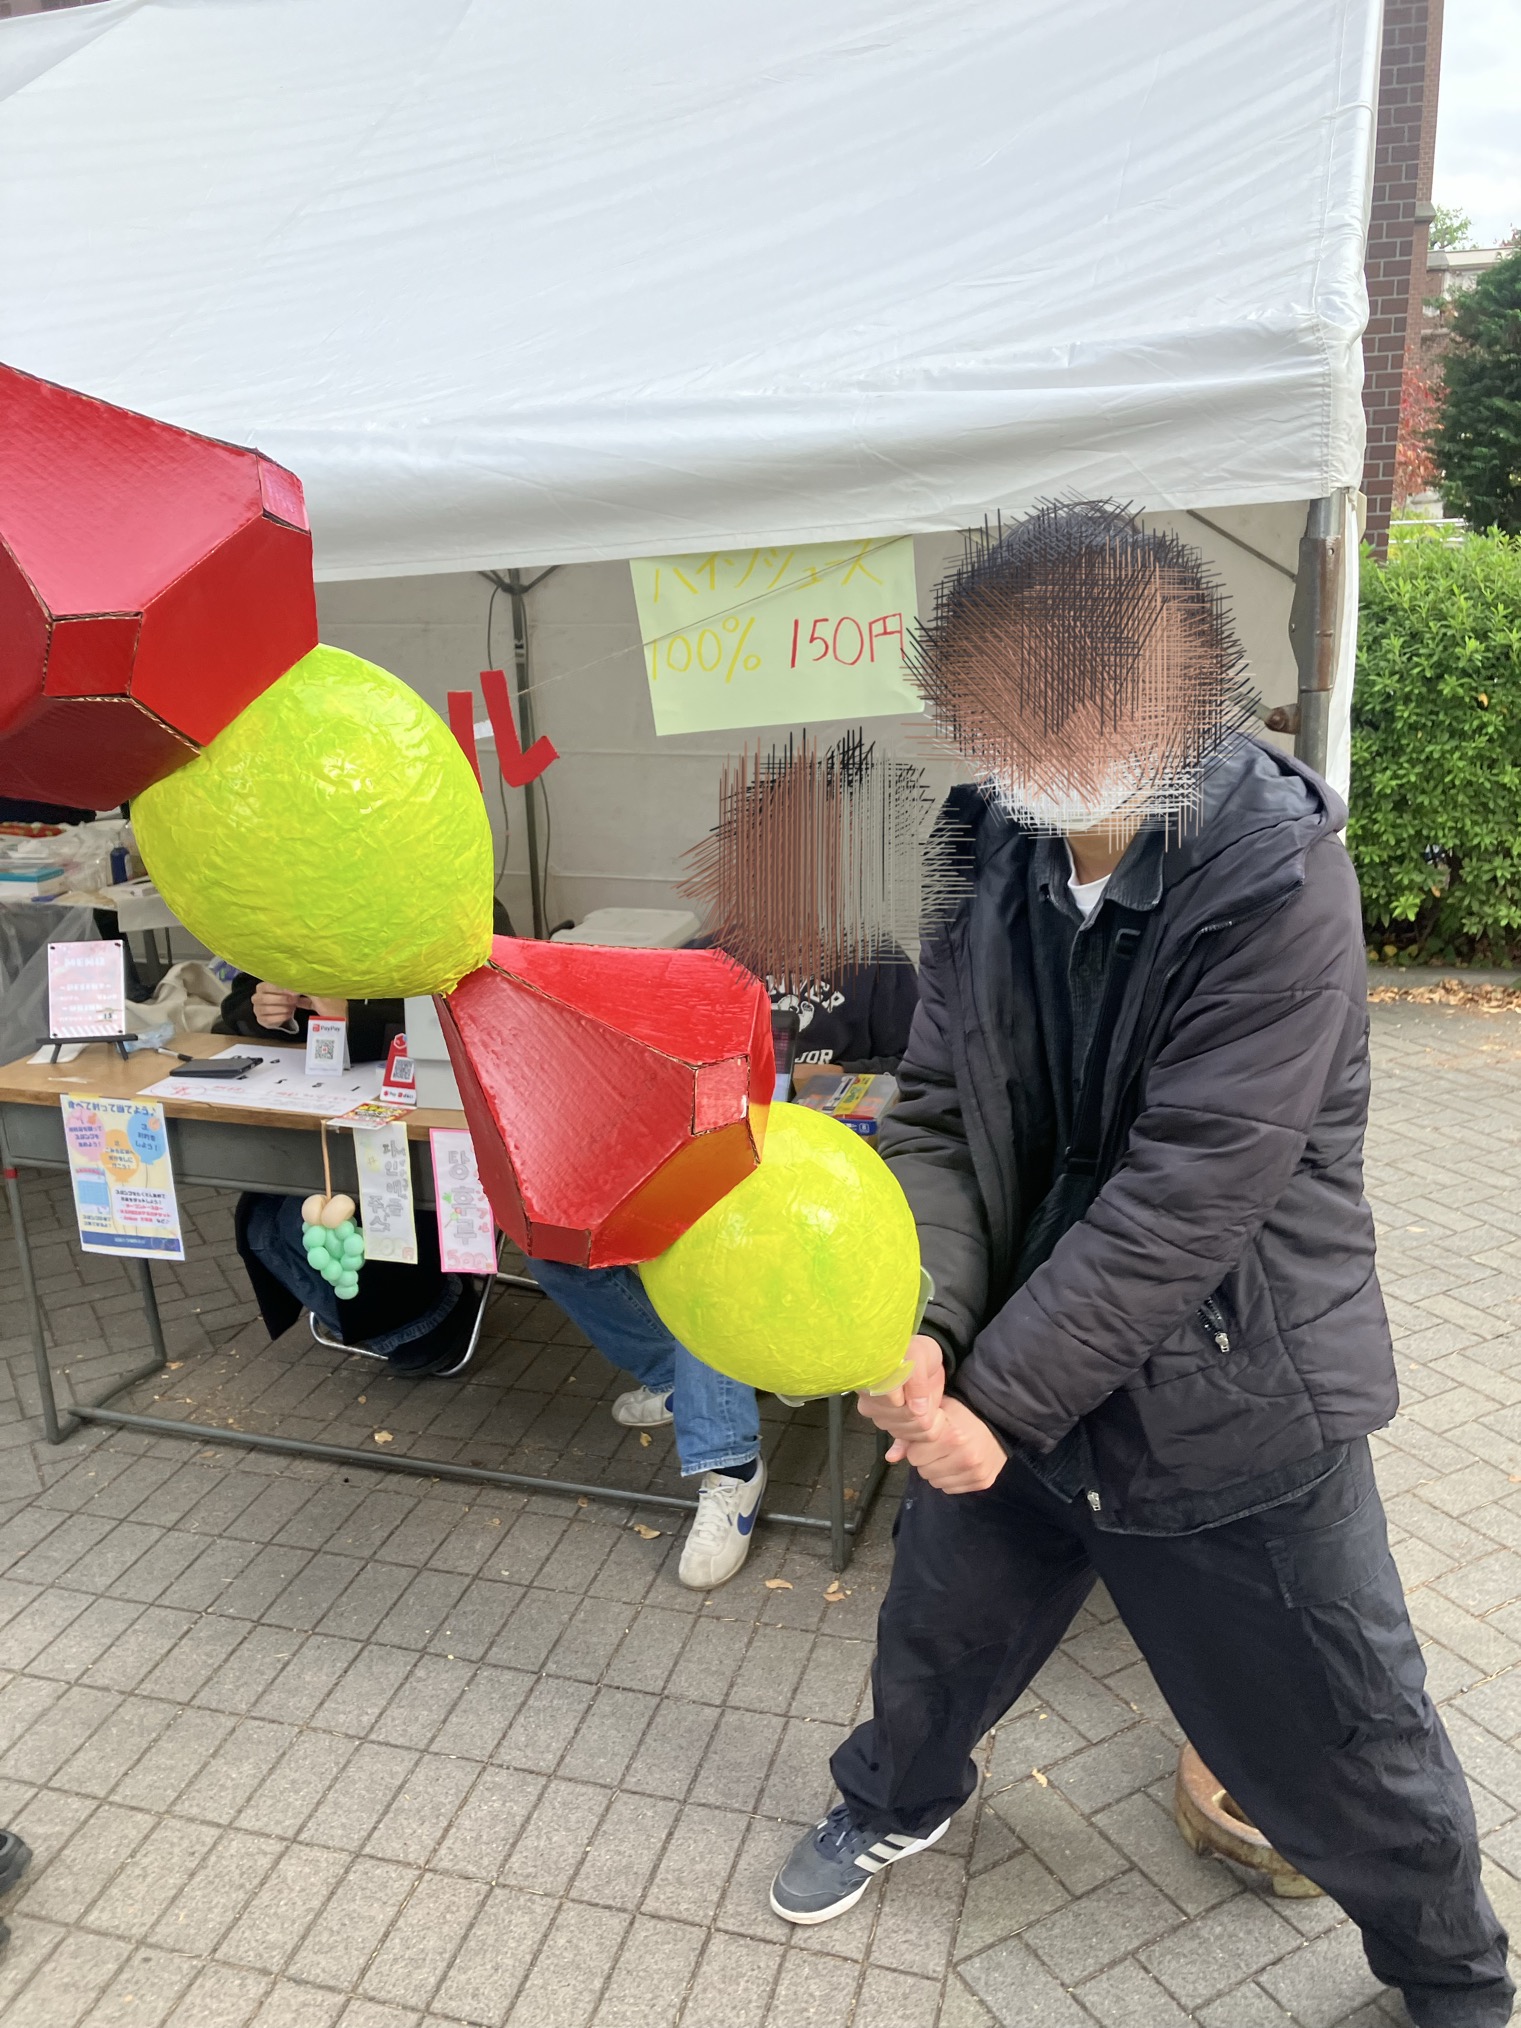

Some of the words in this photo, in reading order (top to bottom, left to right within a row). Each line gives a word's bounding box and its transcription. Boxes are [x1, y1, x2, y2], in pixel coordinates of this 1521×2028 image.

[652, 615, 762, 684] 100%
[790, 612, 905, 669] 150円
[794, 1049, 833, 1065] JOR
